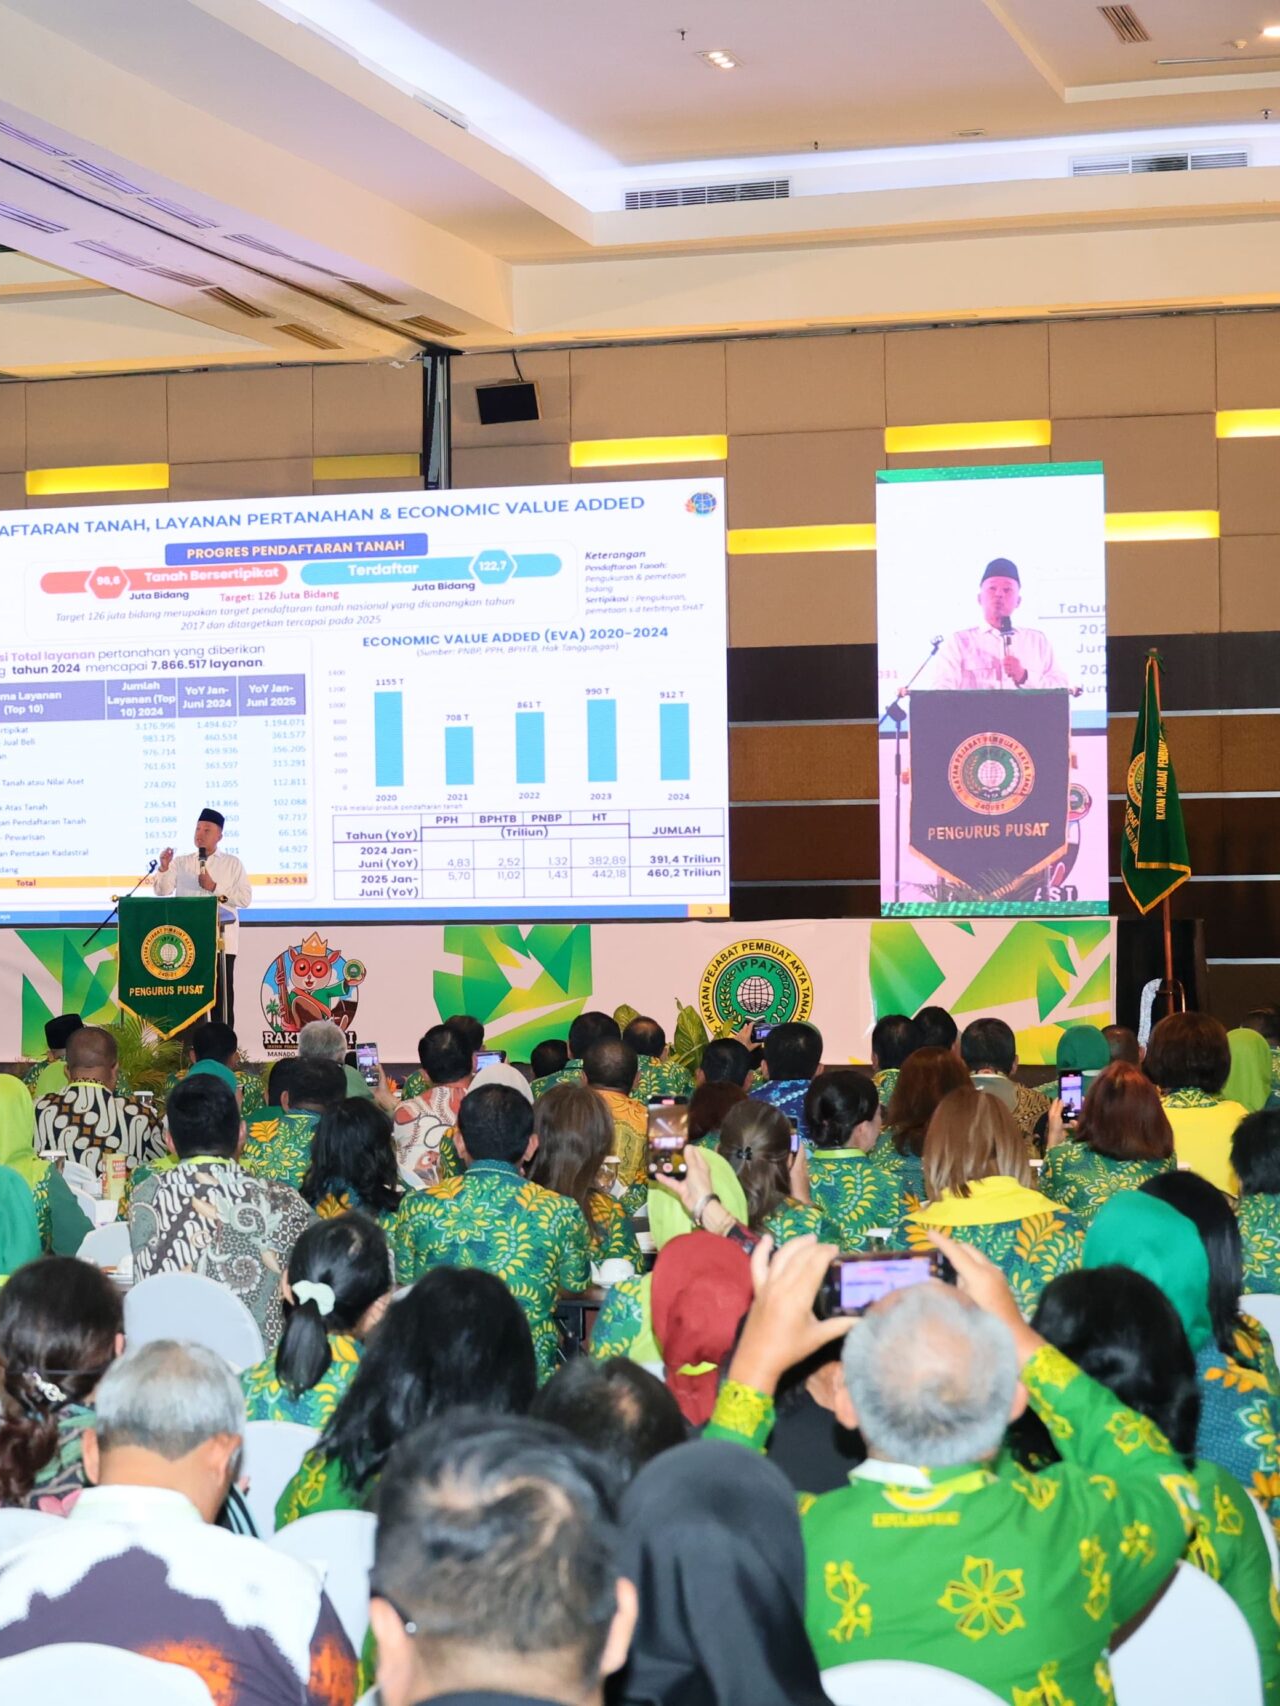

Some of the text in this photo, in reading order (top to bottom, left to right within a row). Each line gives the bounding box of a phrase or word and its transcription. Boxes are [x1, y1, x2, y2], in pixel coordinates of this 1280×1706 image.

[84, 518, 151, 533] TANAH,
[155, 514, 241, 530] LAYANAN
[247, 508, 373, 526] PERTANAHAN
[380, 508, 391, 520] &
[398, 503, 500, 519] ECONOMIC
[505, 500, 569, 515] VALUE
[574, 496, 645, 512] ADDED
[187, 540, 405, 559] PROGRES PENDAFTARAN TANAH
[585, 550, 646, 561] Keterangan
[347, 562, 420, 577] Terdaftar
[478, 560, 508, 572] 122,7
[144, 567, 279, 583] Tanah Bersertipikat
[411, 581, 476, 593] Juta Bidang
[129, 589, 190, 601] Juta Bidang
[258, 591, 277, 601] 126
[279, 591, 301, 600] Juta
[303, 589, 339, 600] Bidang
[362, 634, 440, 647] ECONOMIC
[444, 633, 488, 645] VALUE
[492, 631, 540, 643] ADDED
[544, 627, 586, 644] (EVA)
[11, 652, 42, 662] Total
[44, 650, 95, 663] layanan
[98, 648, 170, 661] pertanahan
[173, 648, 205, 660] yang
[208, 644, 266, 655] diberikan
[12, 665, 48, 675] tahun
[51, 663, 81, 674] 2024
[85, 662, 148, 674] mencapai
[151, 659, 207, 671] 7.866.517
[185, 685, 229, 696] YoY Jan-
[248, 683, 294, 694] YoY Jan-
[18, 690, 62, 703] Layanan
[183, 698, 232, 709] Juni 2024
[4, 704, 44, 716] (Top 10)
[376, 794, 397, 802] 2020
[447, 793, 468, 802] 2021
[518, 791, 540, 800] 2022
[590, 792, 612, 801] 2023
[668, 792, 690, 801] 2024
[435, 815, 459, 825] PPH
[479, 814, 517, 824] BPHTB
[531, 814, 562, 823] PNBP
[592, 813, 607, 822] HT
[345, 829, 418, 842] Tahun (YoY)
[501, 826, 548, 839] (Triliun)
[652, 826, 701, 836] JUMLAH
[928, 822, 1050, 841] PENGURUS PUSAT
[360, 846, 418, 856] 2024 Jan-
[358, 857, 419, 870] Juni (YoY)
[650, 855, 721, 865] 391,4 Triliun
[361, 874, 418, 885] 2025 Jan-
[647, 868, 721, 879] 460,2 Triliun
[16, 879, 36, 887] Total
[359, 886, 419, 899] Juni (YoY)
[741, 942, 792, 960] PEMBUAT
[704, 946, 740, 984] PEJABAT
[735, 958, 777, 973] IPPAT
[789, 959, 808, 985] AKTA
[129, 984, 205, 997] PENGURUS PUSAT
[702, 985, 715, 1024] IKATAN
[267, 1050, 296, 1058] MANADO
